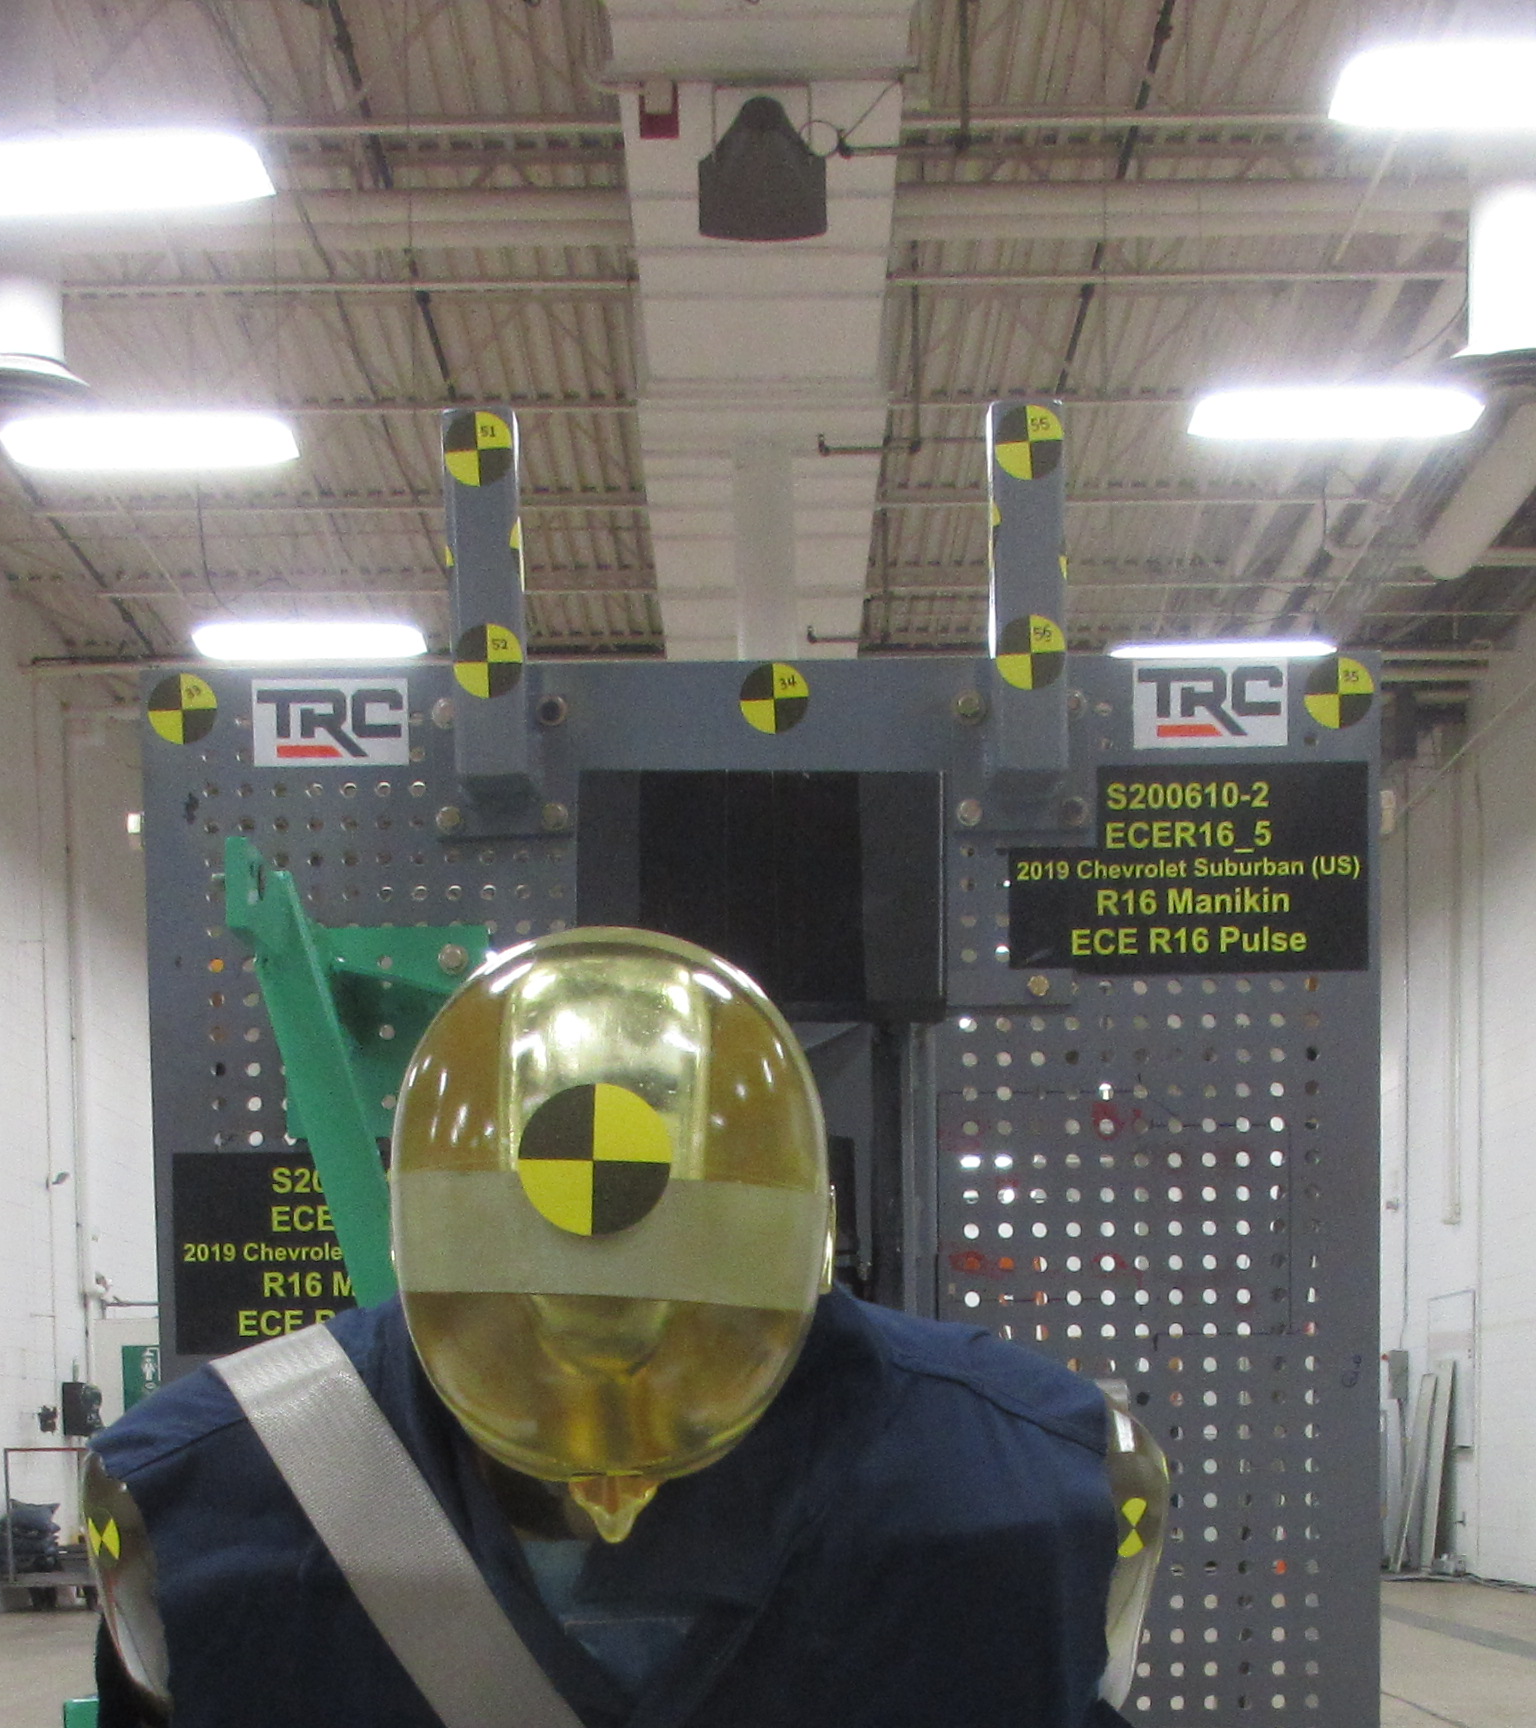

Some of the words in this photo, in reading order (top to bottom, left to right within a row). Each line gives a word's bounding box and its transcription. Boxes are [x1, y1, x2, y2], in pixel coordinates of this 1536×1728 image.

[480, 425, 496, 438] 51
[1030, 416, 1051, 432] 55
[491, 638, 508, 651] 52
[779, 674, 797, 690] 34
[1137, 665, 1284, 736] TRC
[256, 688, 404, 758] TRC
[1106, 781, 1270, 811] S200610-2
[1105, 820, 1272, 853] ECER16_5
[1016, 860, 1069, 881] 2019
[1076, 858, 1187, 880] Chevrolet
[1193, 857, 1305, 878] Suburban
[1311, 855, 1361, 880] (US)
[1096, 888, 1158, 916] R16
[1167, 887, 1291, 915] Manikin
[1070, 927, 1139, 956] ECE
[1148, 926, 1210, 954] R16
[1219, 925, 1308, 953] Pulse
[183, 1242, 237, 1262] 2019
[263, 1271, 323, 1298] R16
[237, 1309, 305, 1337] ECE
